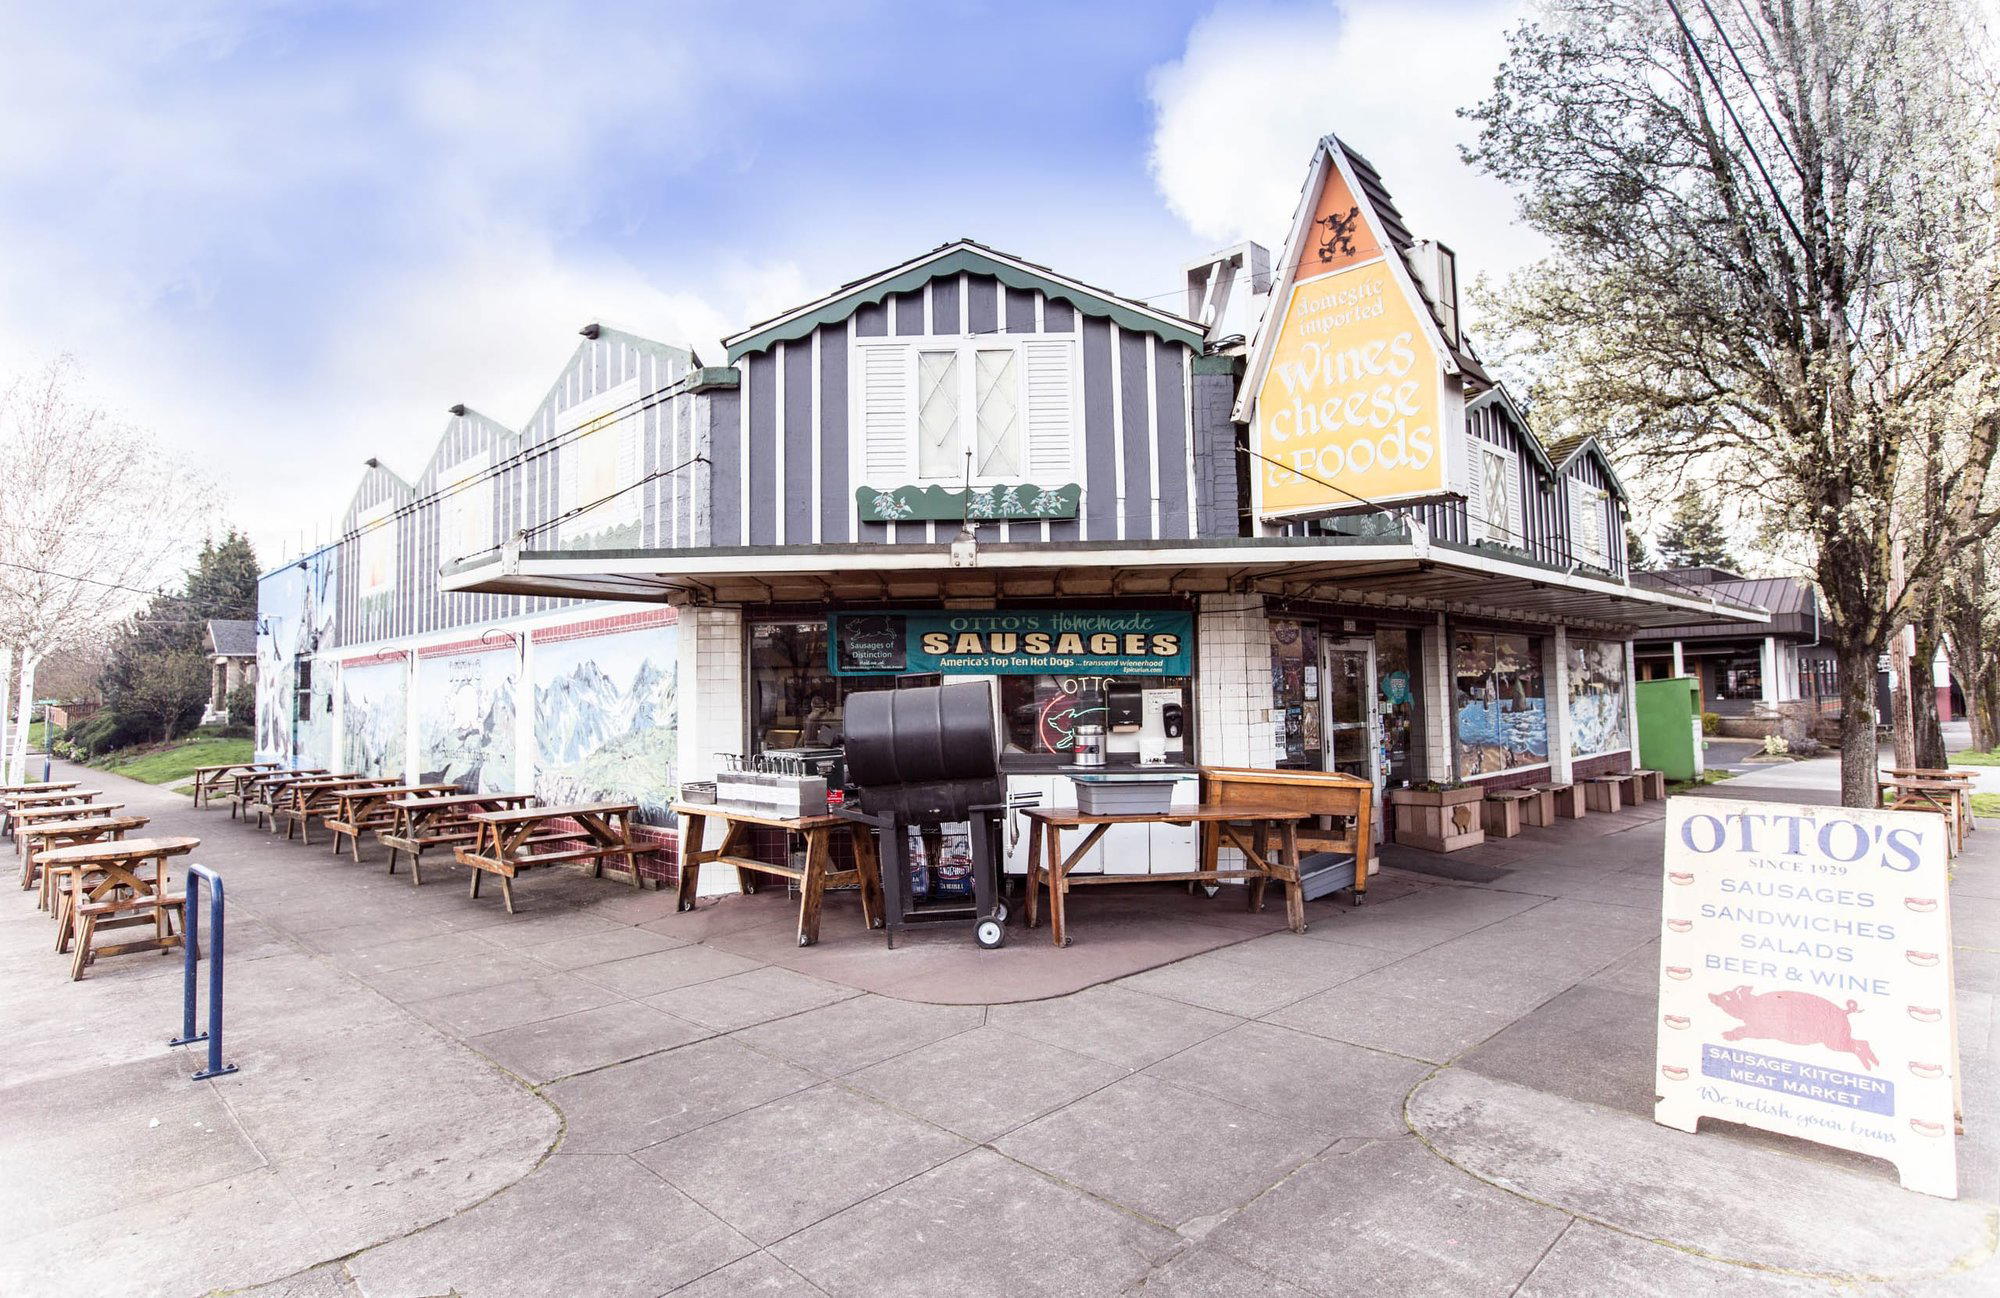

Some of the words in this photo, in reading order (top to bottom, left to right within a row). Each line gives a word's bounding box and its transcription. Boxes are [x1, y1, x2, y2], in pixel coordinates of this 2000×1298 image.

[1300, 297, 1385, 337] imported
[1274, 331, 1416, 395] Wines
[1270, 381, 1422, 443] cheese
[950, 616, 1040, 631] OTTO'S
[1051, 612, 1154, 632] Homemade
[850, 641, 884, 651] Sausages
[885, 640, 894, 650] of
[852, 651, 893, 659] Distinction
[923, 632, 1179, 656] SAUSAGES
[940, 657, 989, 667] America's
[991, 657, 1009, 668] Top
[1010, 657, 1028, 667] Ten
[1030, 657, 1047, 667] Hot
[1049, 657, 1074, 668] Dogs
[1681, 813, 1923, 872] OTTO'S
[1749, 857, 1803, 873] SINCE
[1811, 864, 1848, 876] 1929
[1720, 878, 1875, 908] SAUSAGES
[1700, 904, 1896, 940] SANDWICHES
[1740, 933, 1854, 962] SALADS
[1705, 954, 1777, 978] BEER
[1785, 966, 1803, 982] &
[1810, 969, 1891, 996] WINE
[1709, 1047, 1793, 1075] SAUSAGE
[1799, 1066, 1886, 1094] KITCHEN
[1730, 1068, 1777, 1088] MEAT
[1783, 1079, 1862, 1106] MARKET
[1697, 1085, 1732, 1106] We
[1736, 1097, 1793, 1121] relish
[1796, 1113, 1846, 1132] your
[1850, 1120, 1897, 1144] buns
